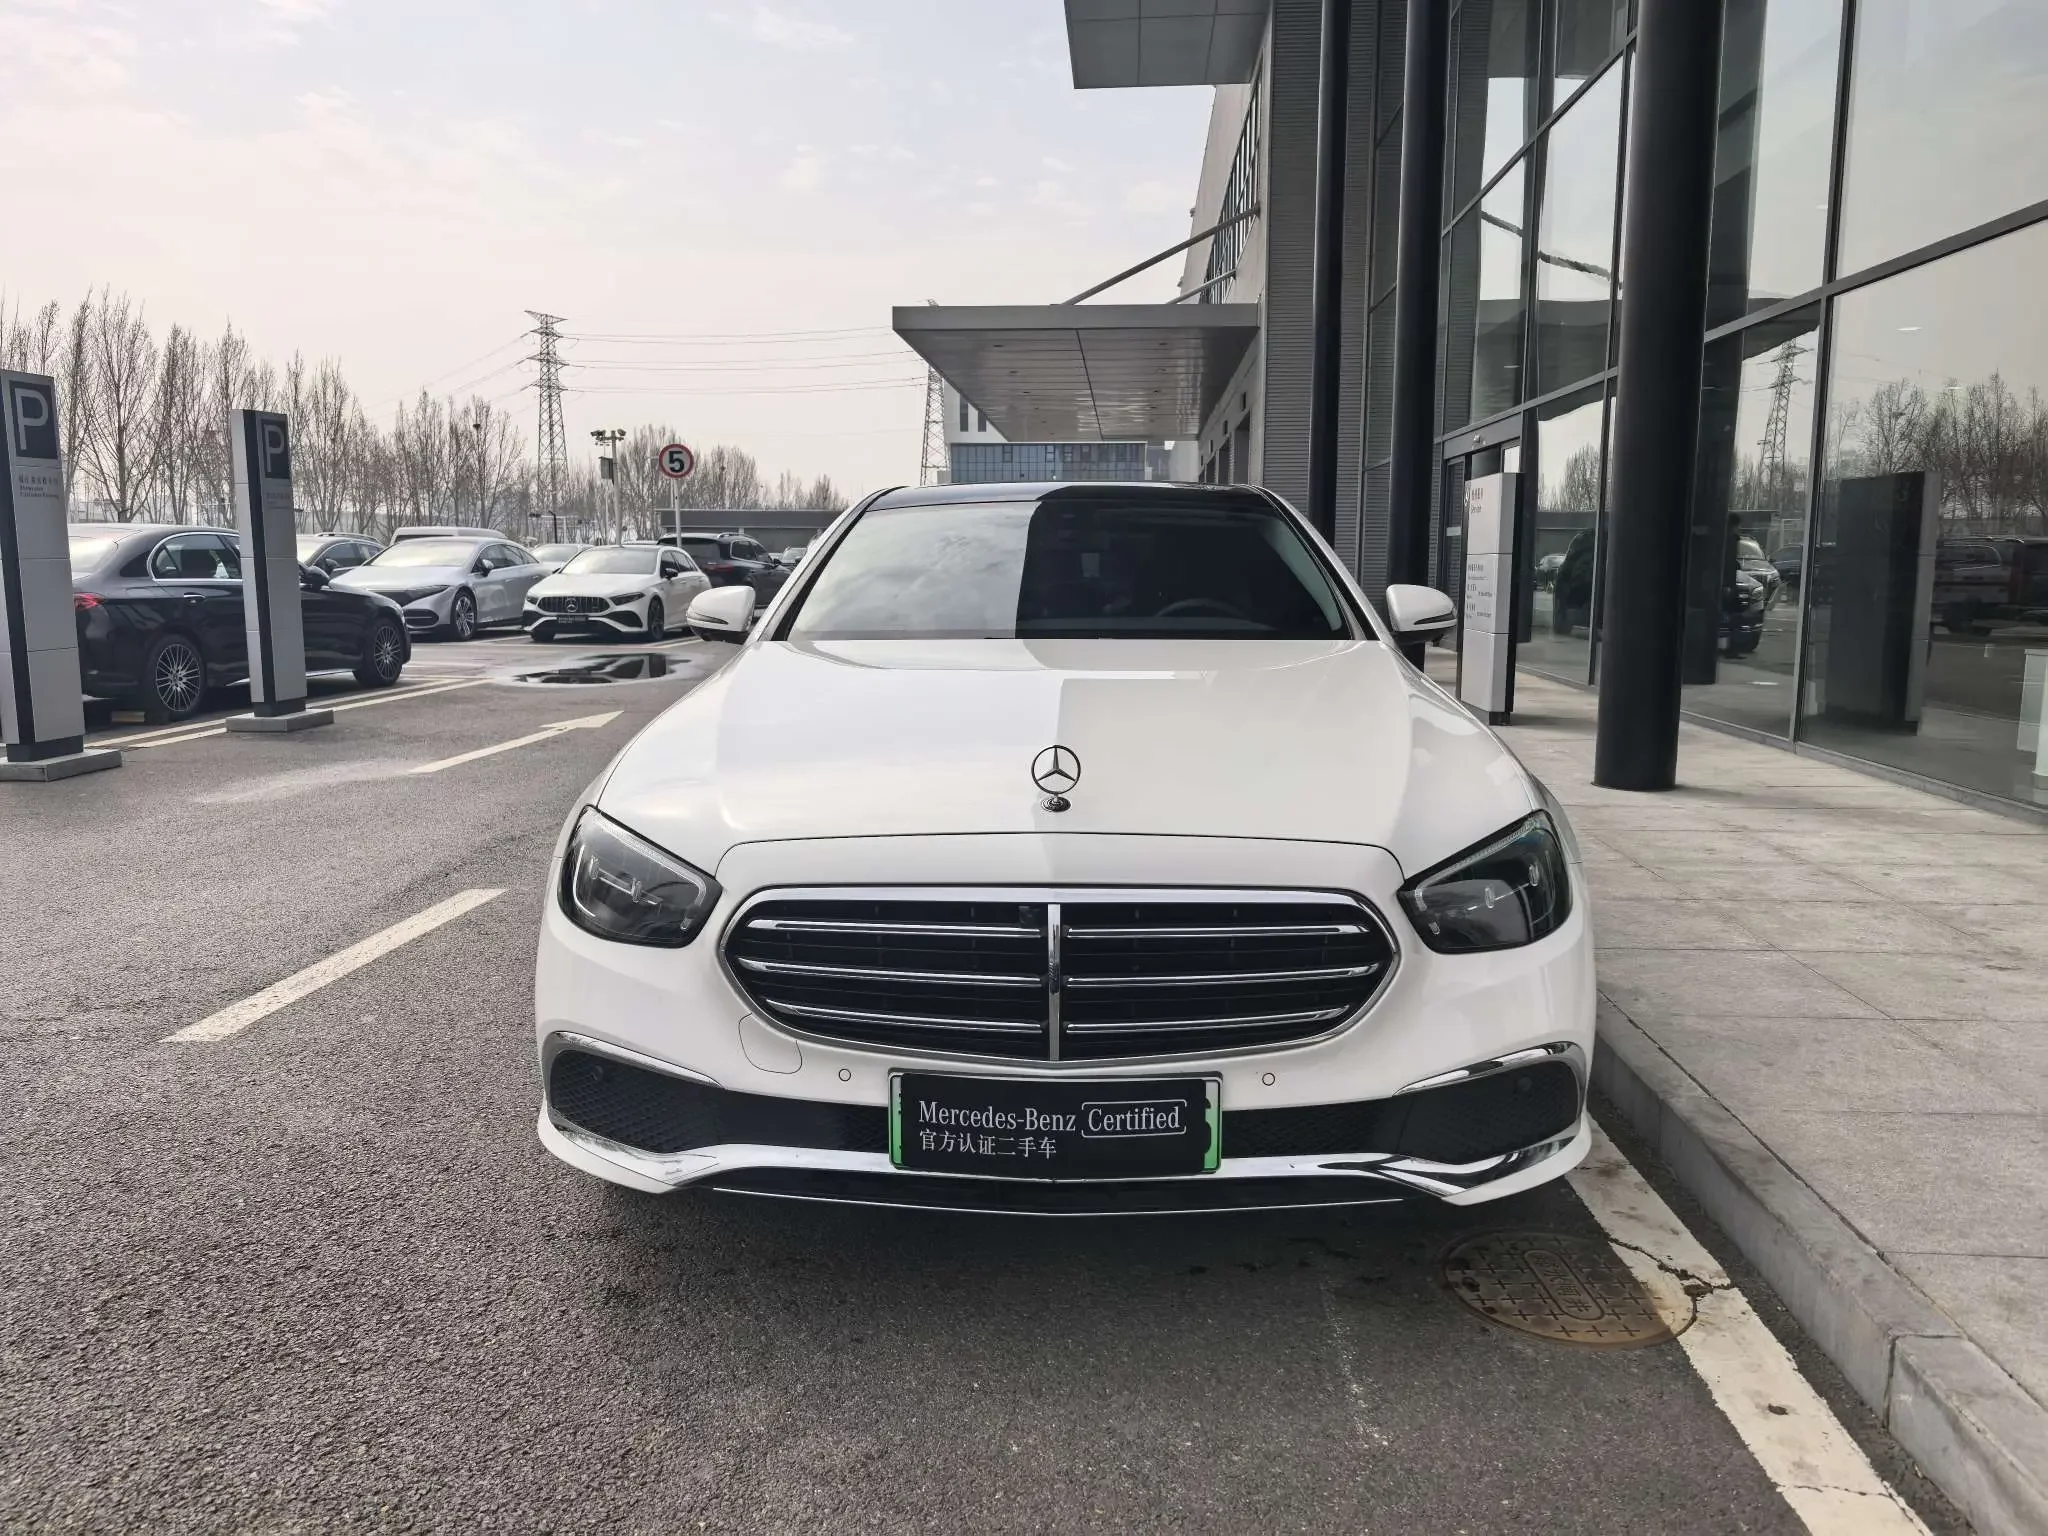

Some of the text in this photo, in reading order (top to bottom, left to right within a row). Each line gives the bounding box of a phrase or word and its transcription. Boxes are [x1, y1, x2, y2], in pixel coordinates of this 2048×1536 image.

[16, 388, 48, 450] P
[265, 425, 285, 472] P
[669, 451, 684, 473] 5
[919, 1101, 1180, 1132] Mercedes-Benz Certified
[919, 1129, 1057, 1159] 官方认证二手车
